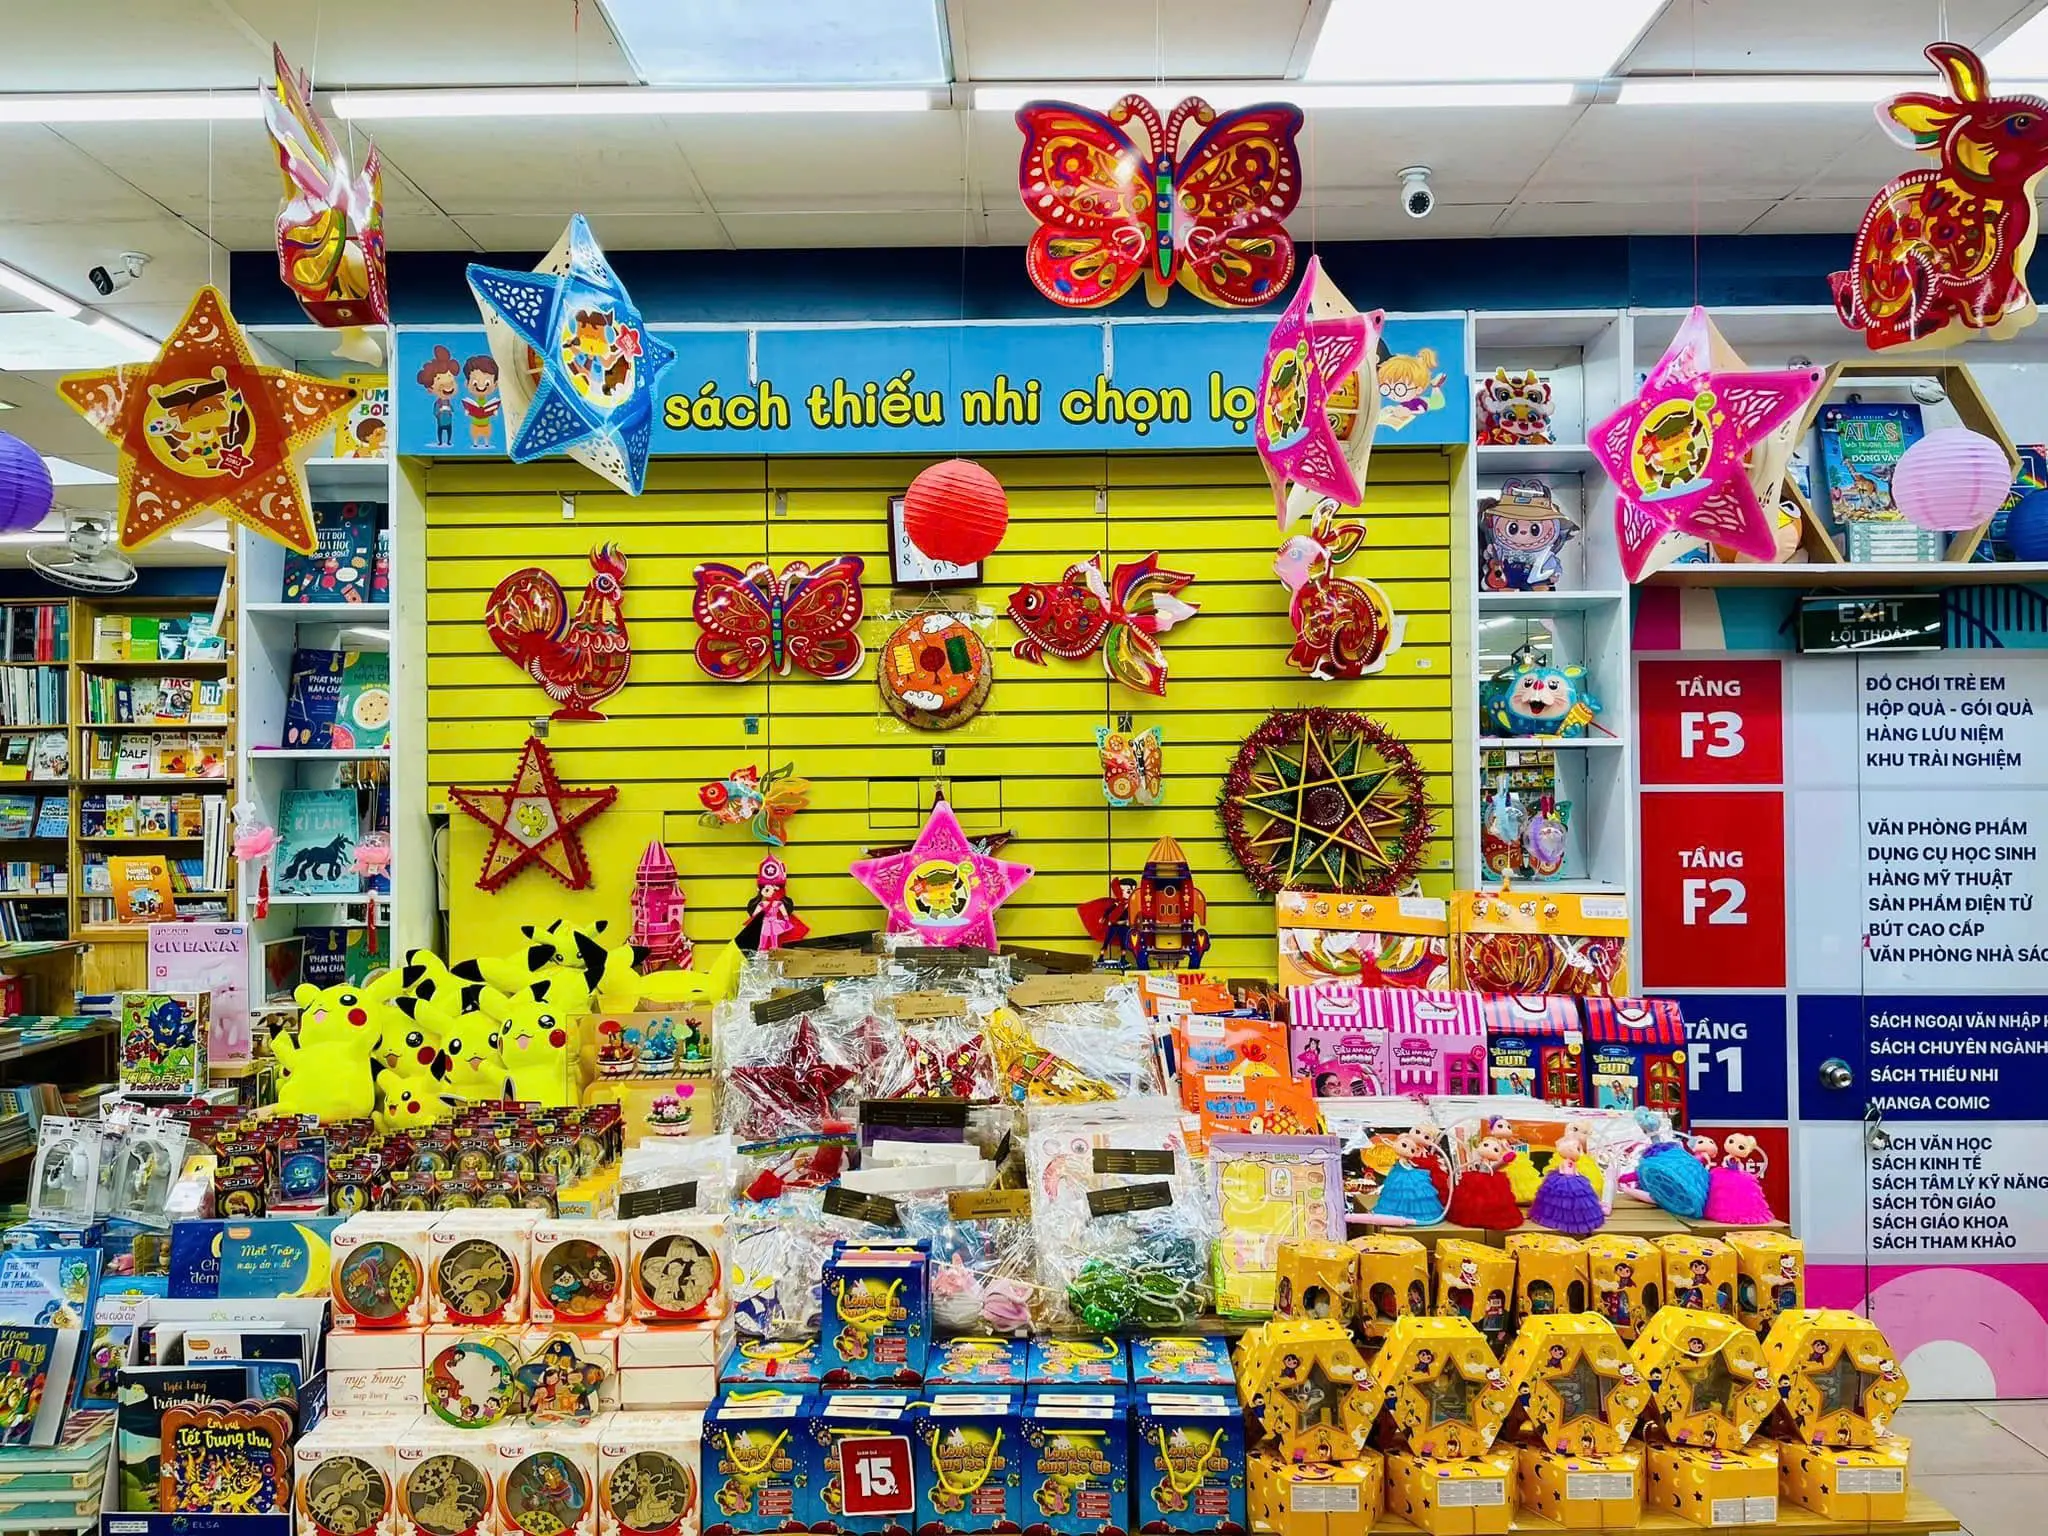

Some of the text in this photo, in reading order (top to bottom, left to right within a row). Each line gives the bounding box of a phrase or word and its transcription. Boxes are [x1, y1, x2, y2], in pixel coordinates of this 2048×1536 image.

[664, 369, 1256, 435] sách thiếu nhi chọn lọ
[1844, 422, 1898, 441] ATLAS
[903, 553, 911, 566] 8
[933, 564, 942, 574] 6
[1838, 602, 1903, 622] EXIT
[1677, 674, 1741, 697] TẦNG
[1896, 675, 1940, 691] CHƠI
[1944, 673, 1976, 691] TRẺ
[1980, 677, 2005, 691] EM
[1866, 698, 2034, 719] HỘP QUÀ GÓI QUÀ
[1680, 711, 1745, 758] F3
[1866, 724, 2004, 745] HÀNG LƯU NIỆM
[120, 749, 148, 759] DALF
[1866, 752, 1904, 767] KHU
[1952, 749, 2022, 770] NGHIỆM
[1867, 818, 1904, 836] VĂN
[1908, 818, 1972, 836] PHÒNG
[1678, 845, 1744, 868] TẦNG
[1868, 846, 2037, 865] DỤNG CỤ HỌC SINH
[1868, 868, 2013, 889] HÀNG MỸ THUẬT
[1682, 877, 1748, 925] F2
[1965, 893, 2006, 915] ĐIỆN
[1869, 919, 1985, 937] BÚT CAO CẤP
[154, 941, 240, 953] GIVEAWAY
[1870, 944, 1905, 962] VĂN
[1908, 944, 1973, 962] PHÒNG
[1976, 945, 2015, 962] NHÀ
[1178, 974, 1205, 985] DIY
[1684, 1017, 1748, 1040] TẦNG
[1869, 1011, 1912, 1028] SÁCH
[1914, 1014, 1963, 1032] NGOẠI
[1965, 1012, 1996, 1028] VĂN
[1999, 1011, 2041, 1032] NHẬP
[1870, 1037, 2048, 1055] SÁCH CHUYÊN NGÀNH
[1687, 1043, 1743, 1093] F1
[1870, 1065, 1999, 1082] SÁCH THIẾU NHI
[1871, 1096, 1990, 1110] MANGA COMIC
[225, 1143, 257, 1153] モンコレ
[1874, 1134, 1993, 1154] ÁCH VĂN HỌC
[1871, 1154, 1982, 1171] SÁCH KINH TẾ
[223, 1177, 255, 1187] モンコレ
[336, 1172, 364, 1182] モンコレ
[1872, 1174, 1917, 1190] SÁCH
[1919, 1174, 1954, 1190] TÂM
[1957, 1173, 1976, 1190] LÝ
[1978, 1173, 2001, 1190] KỸ
[1872, 1193, 1996, 1210] SÁCH TÔN GIÁO
[1872, 1213, 2009, 1230] SÁCH GIÁO KHOA
[1872, 1233, 1917, 1249] SÁCH
[1920, 1235, 1968, 1249] THAM
[179, 1427, 272, 1449] Tết Trung thu
[856, 1457, 899, 1497] 15%
[192, 1521, 220, 1529] ELSA
